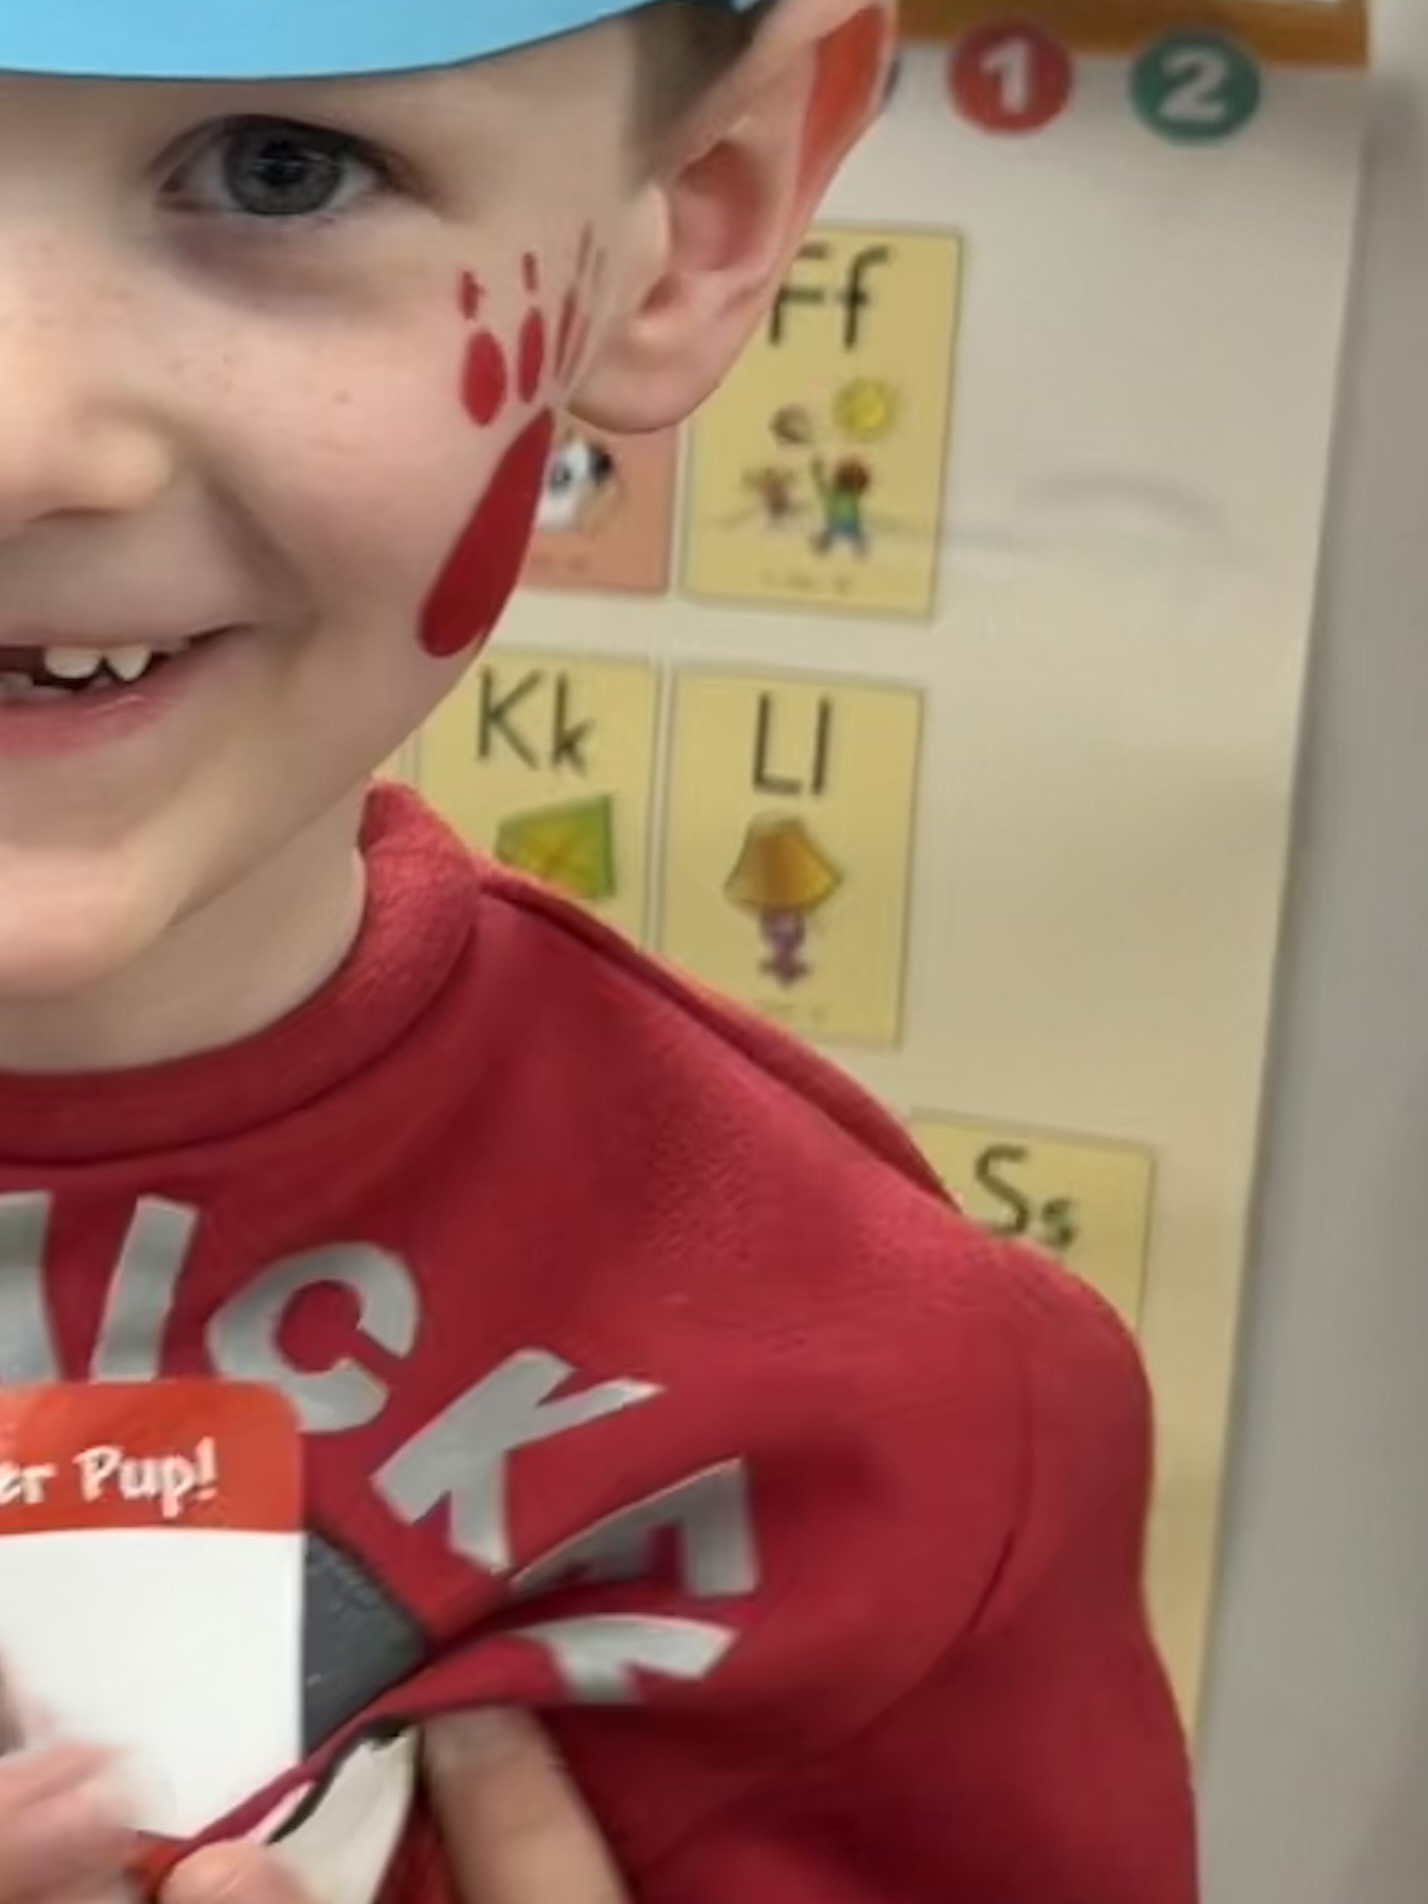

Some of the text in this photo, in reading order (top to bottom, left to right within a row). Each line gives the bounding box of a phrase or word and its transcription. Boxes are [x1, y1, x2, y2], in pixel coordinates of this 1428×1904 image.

[980, 37, 1231, 122] 1 2
[768, 243, 890, 351] Ff
[475, 664, 594, 775] Kk
[974, 1143, 1077, 1251] Ss
[74, 1436, 218, 1519] Pup!
